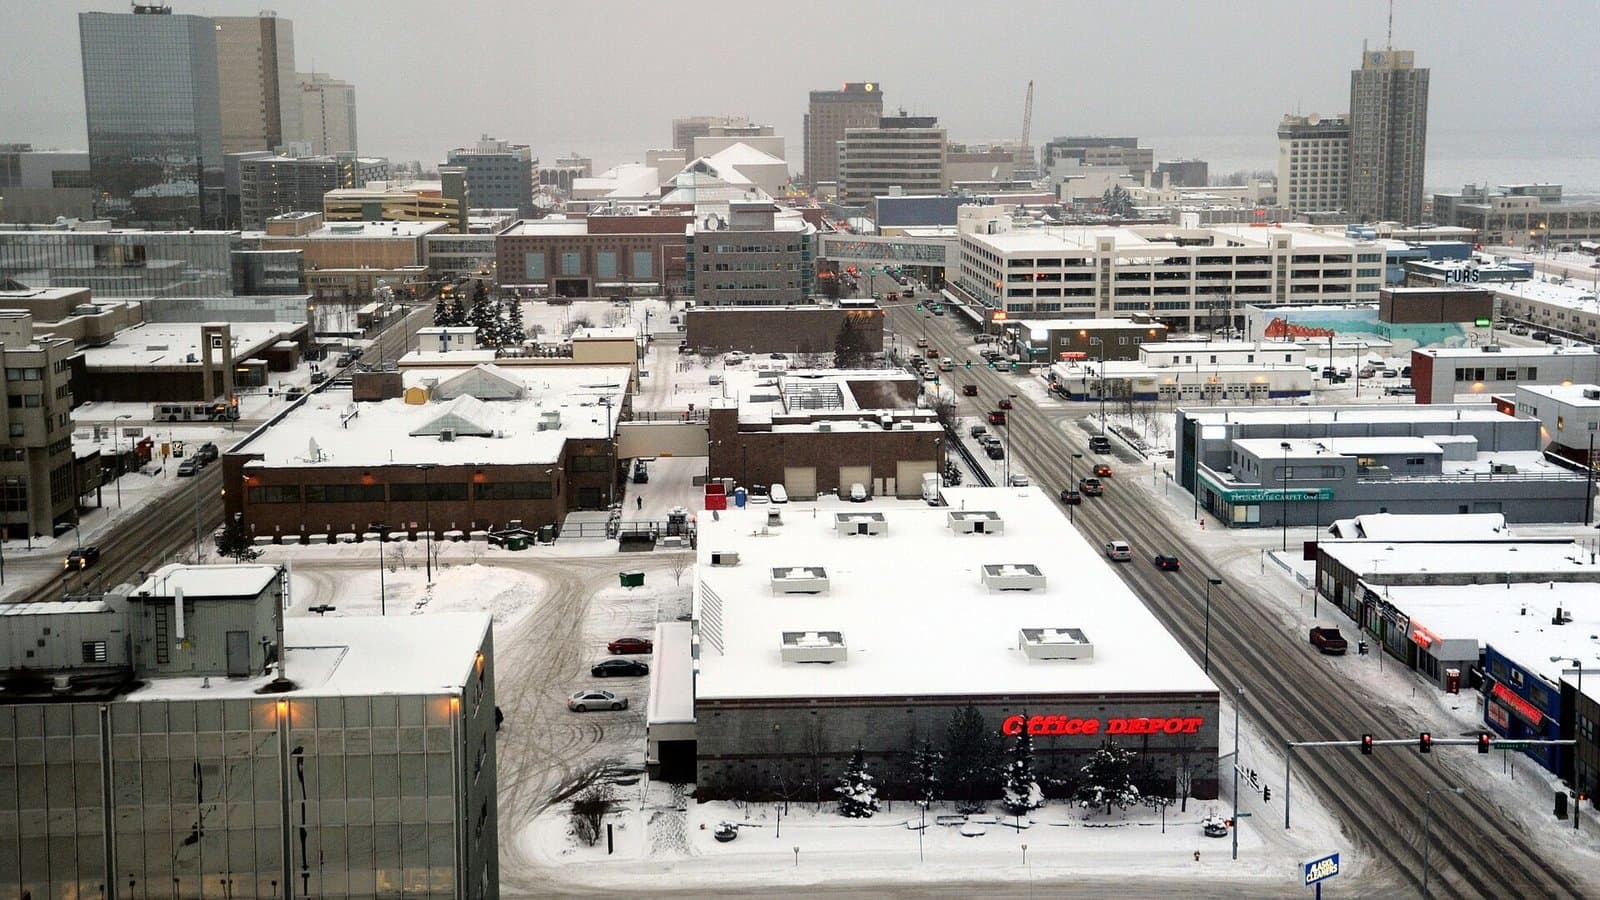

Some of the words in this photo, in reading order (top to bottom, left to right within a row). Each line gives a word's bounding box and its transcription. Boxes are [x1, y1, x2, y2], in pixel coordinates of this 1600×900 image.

[1445, 269, 1479, 282] FURS
[1002, 715, 1100, 735] Office
[1105, 717, 1203, 735] DEPOT
[1306, 864, 1338, 882] CLEANERS
